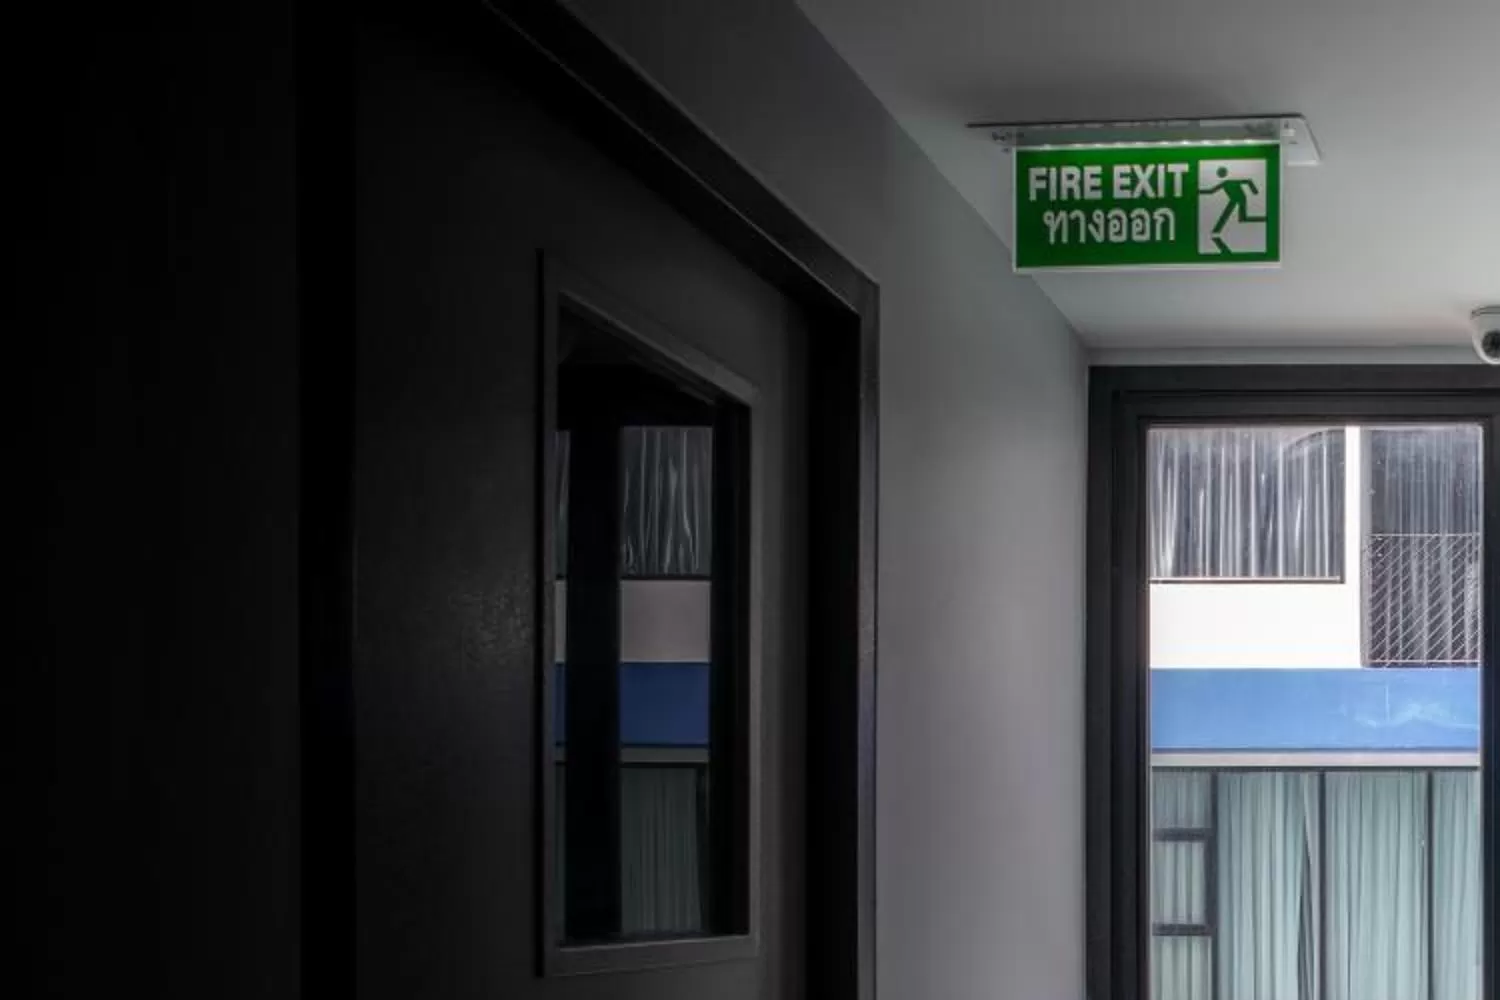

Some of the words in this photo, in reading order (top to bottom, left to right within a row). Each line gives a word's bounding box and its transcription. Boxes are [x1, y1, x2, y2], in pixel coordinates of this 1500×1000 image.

[1028, 165, 1102, 201] FIRE
[1113, 163, 1189, 199] EXIT
[1043, 207, 1176, 245] ทางออก
